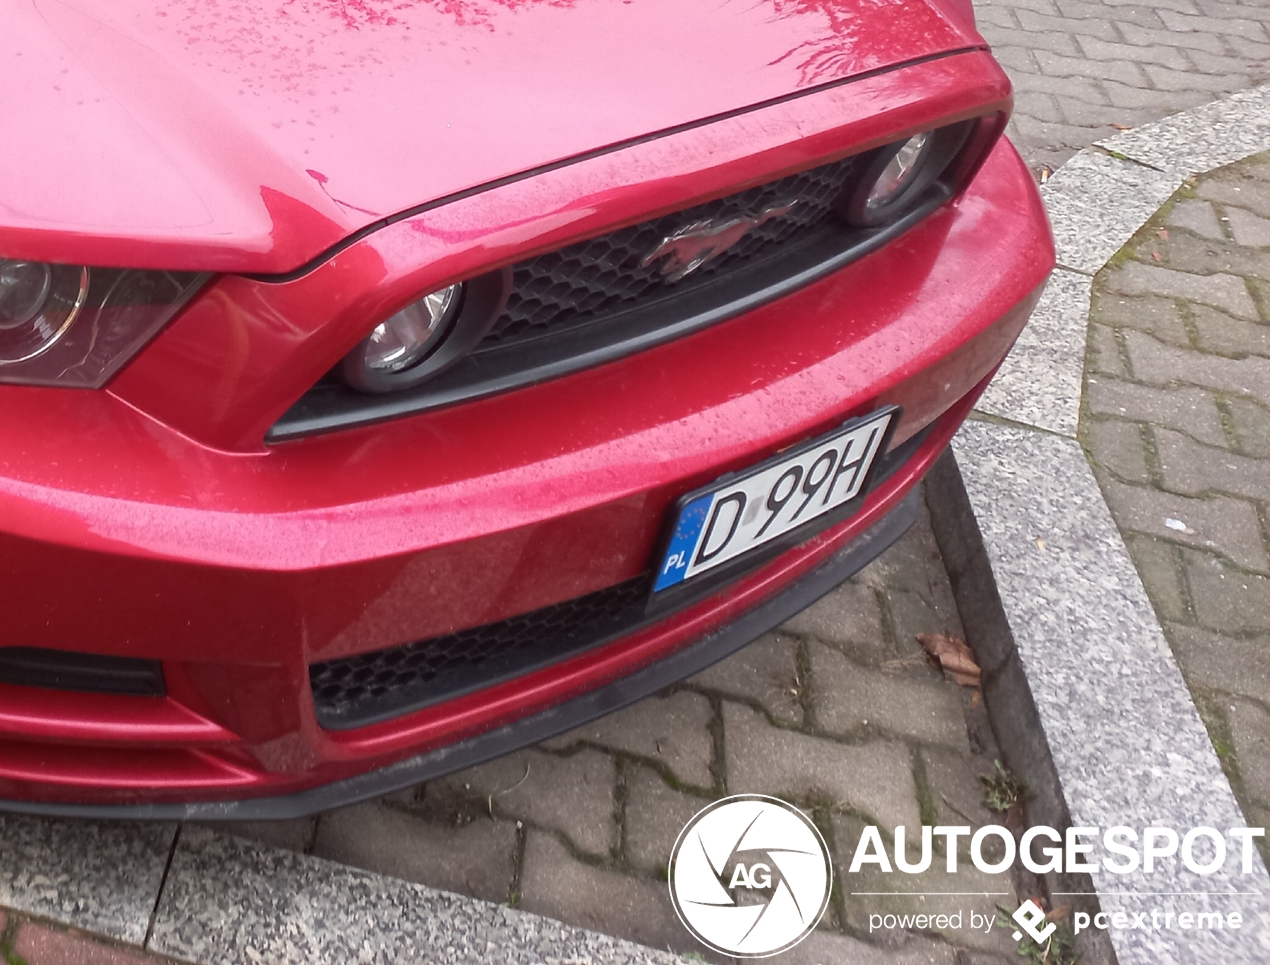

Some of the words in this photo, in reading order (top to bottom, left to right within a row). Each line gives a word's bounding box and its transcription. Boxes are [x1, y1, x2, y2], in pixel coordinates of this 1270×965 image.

[692, 490, 747, 568] D
[753, 427, 879, 540] 99H
[663, 553, 686, 575] PL
